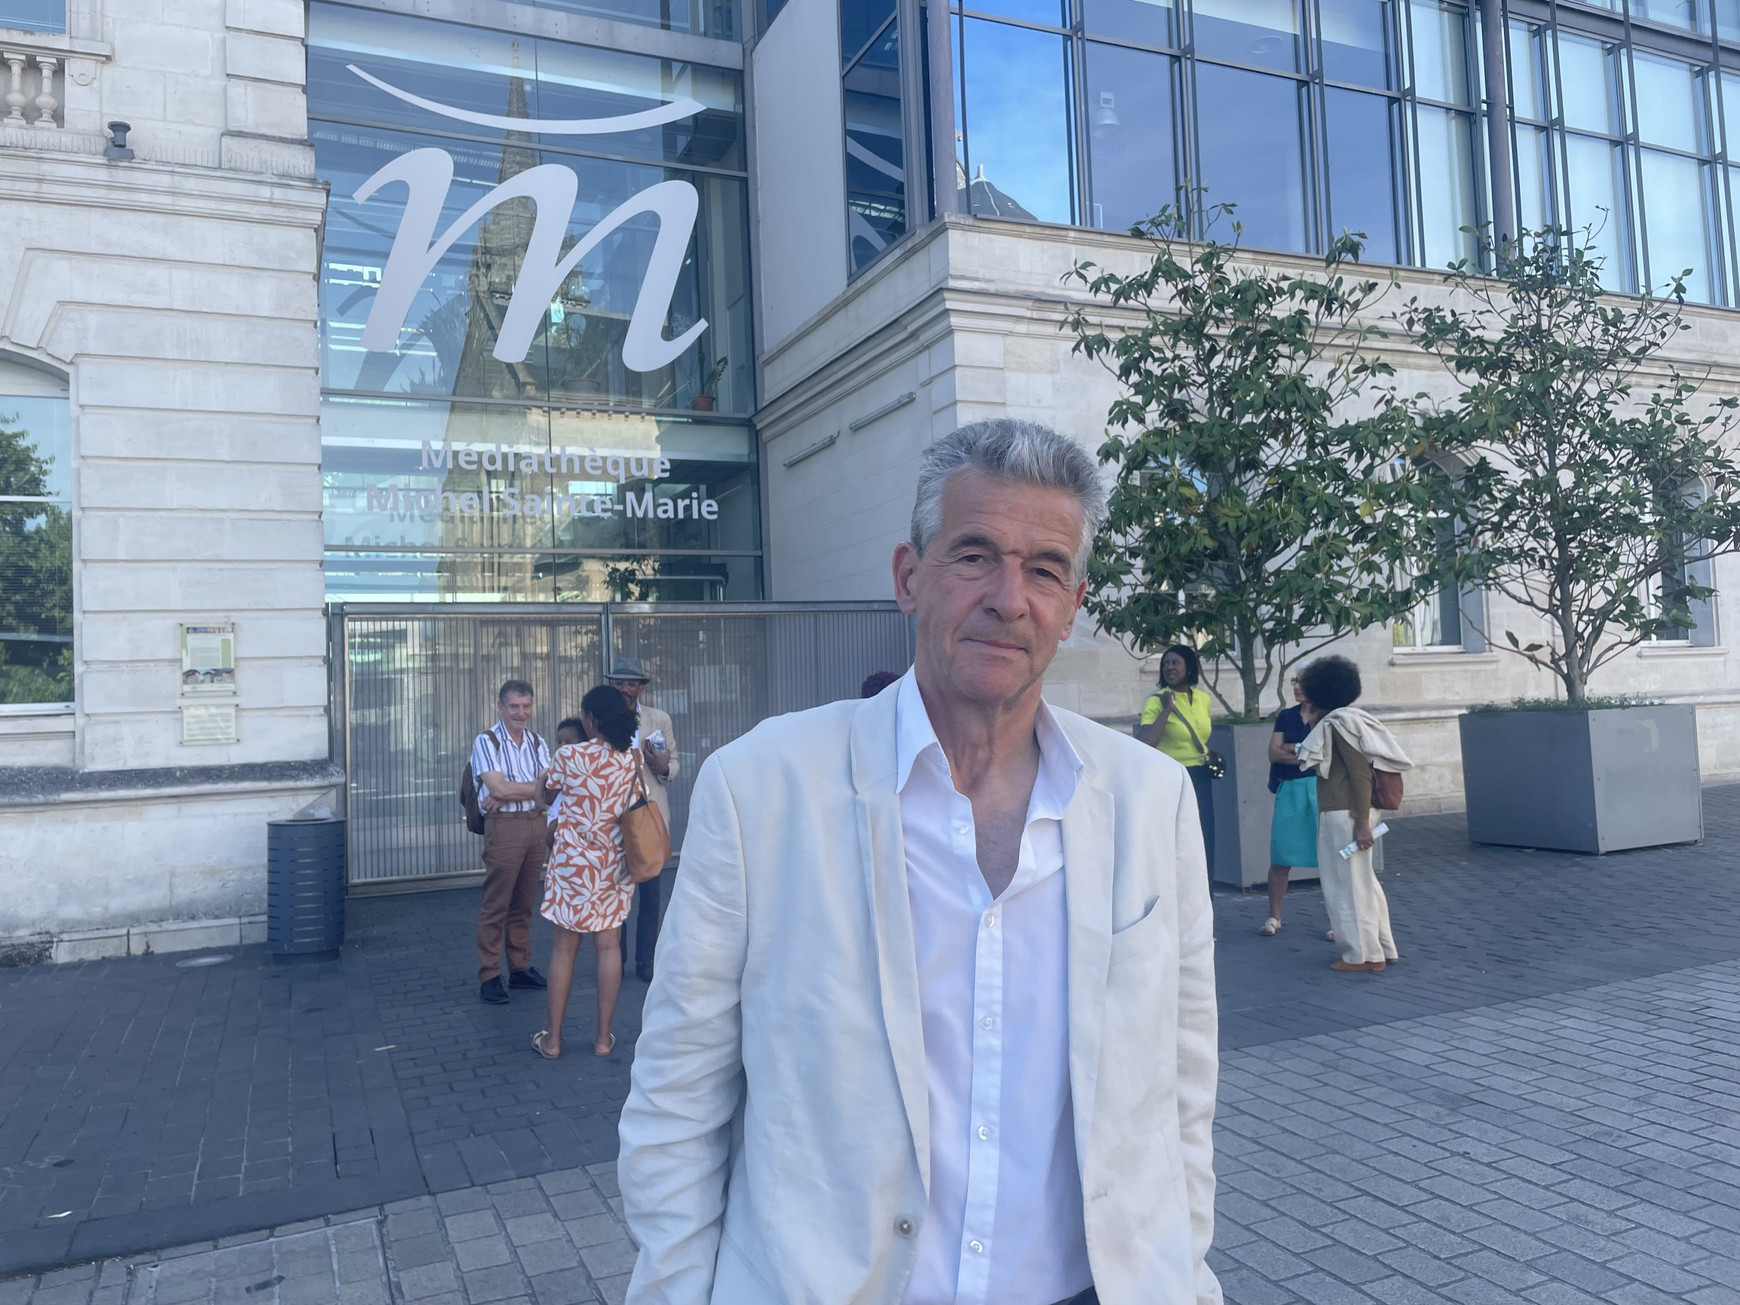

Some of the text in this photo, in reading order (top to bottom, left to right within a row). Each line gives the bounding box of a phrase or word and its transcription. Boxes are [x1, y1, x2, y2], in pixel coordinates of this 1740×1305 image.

[421, 440, 671, 484] Médiathèque
[366, 483, 719, 520] Michel Sainte-Marie
